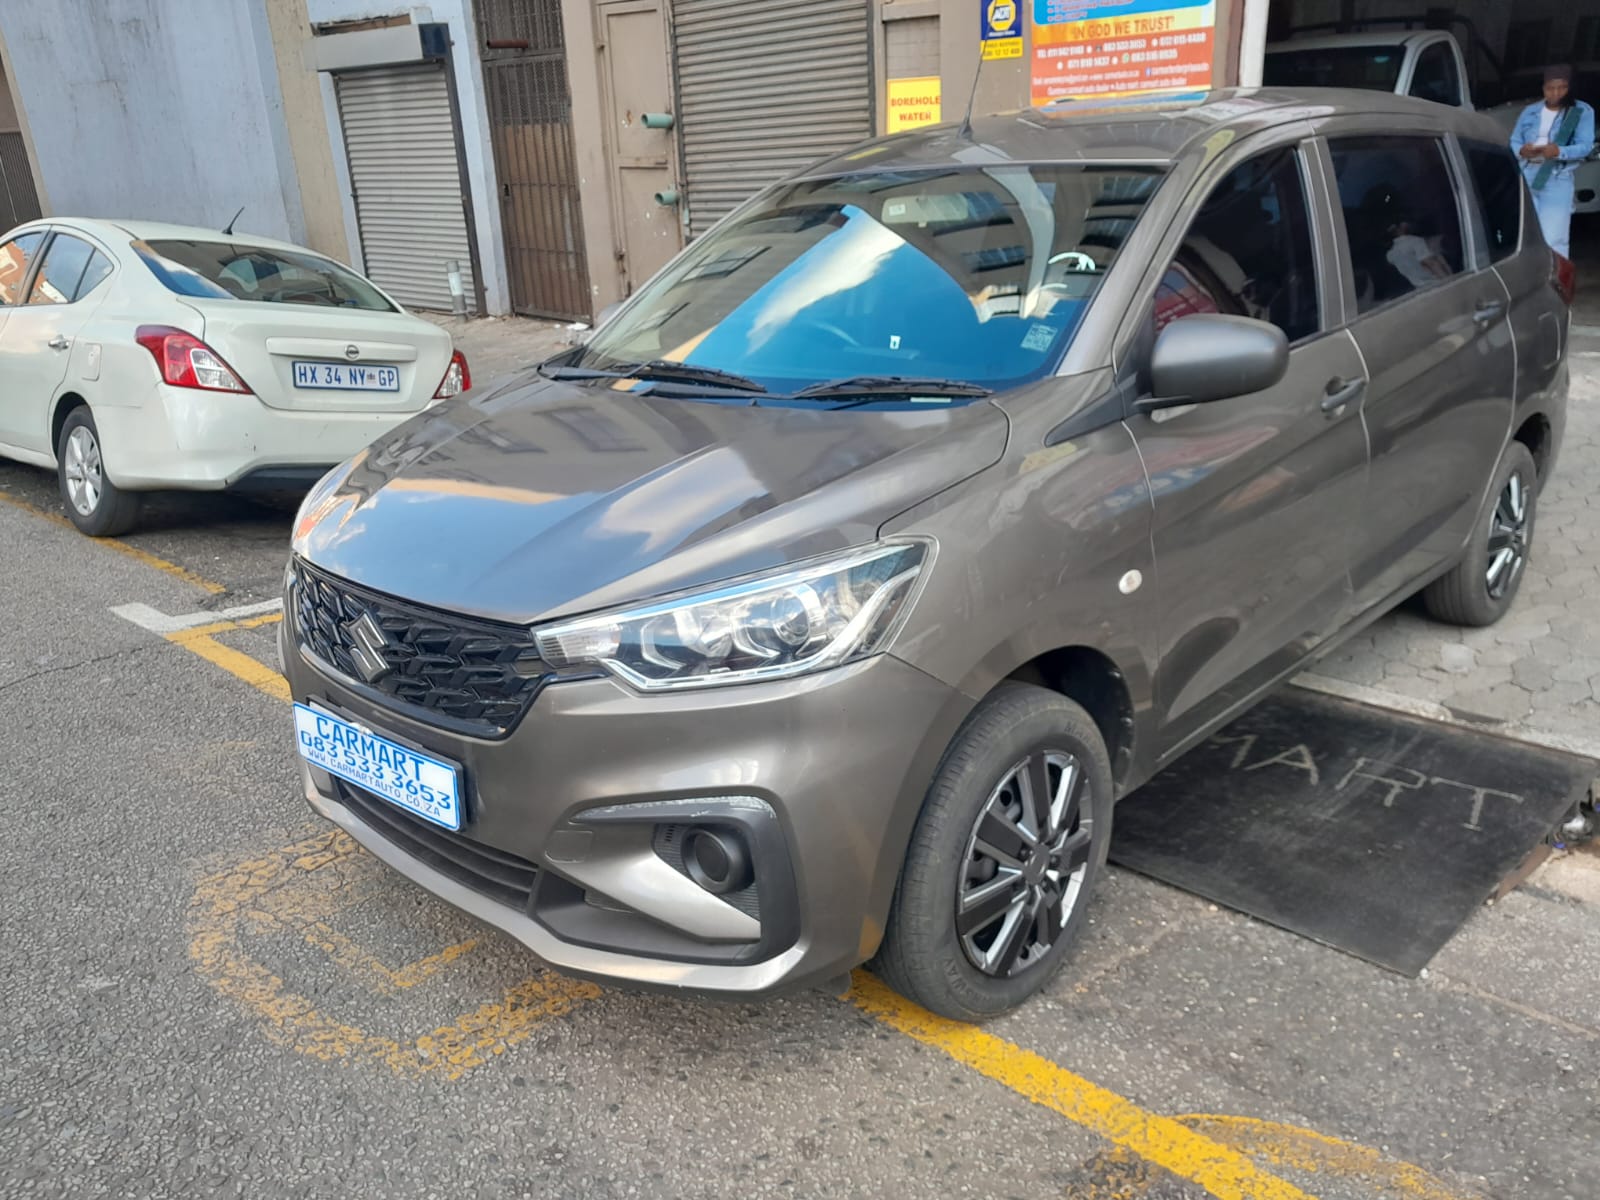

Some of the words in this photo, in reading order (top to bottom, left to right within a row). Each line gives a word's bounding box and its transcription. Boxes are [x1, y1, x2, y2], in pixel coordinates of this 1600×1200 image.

[1087, 23, 1111, 36] GOD
[1114, 20, 1130, 34] WE
[891, 96, 942, 107] BOREHOLE
[899, 111, 932, 121] WATER
[299, 366, 318, 384] HX
[325, 367, 342, 385] 34
[349, 368, 366, 385] NY
[378, 370, 395, 387] GP
[316, 716, 425, 782] CARMART
[301, 730, 339, 758] 083
[344, 751, 385, 780] 533
[391, 771, 451, 810] 3653
[307, 750, 441, 817] WWW.CARMARTAUTO.CO.ZA
